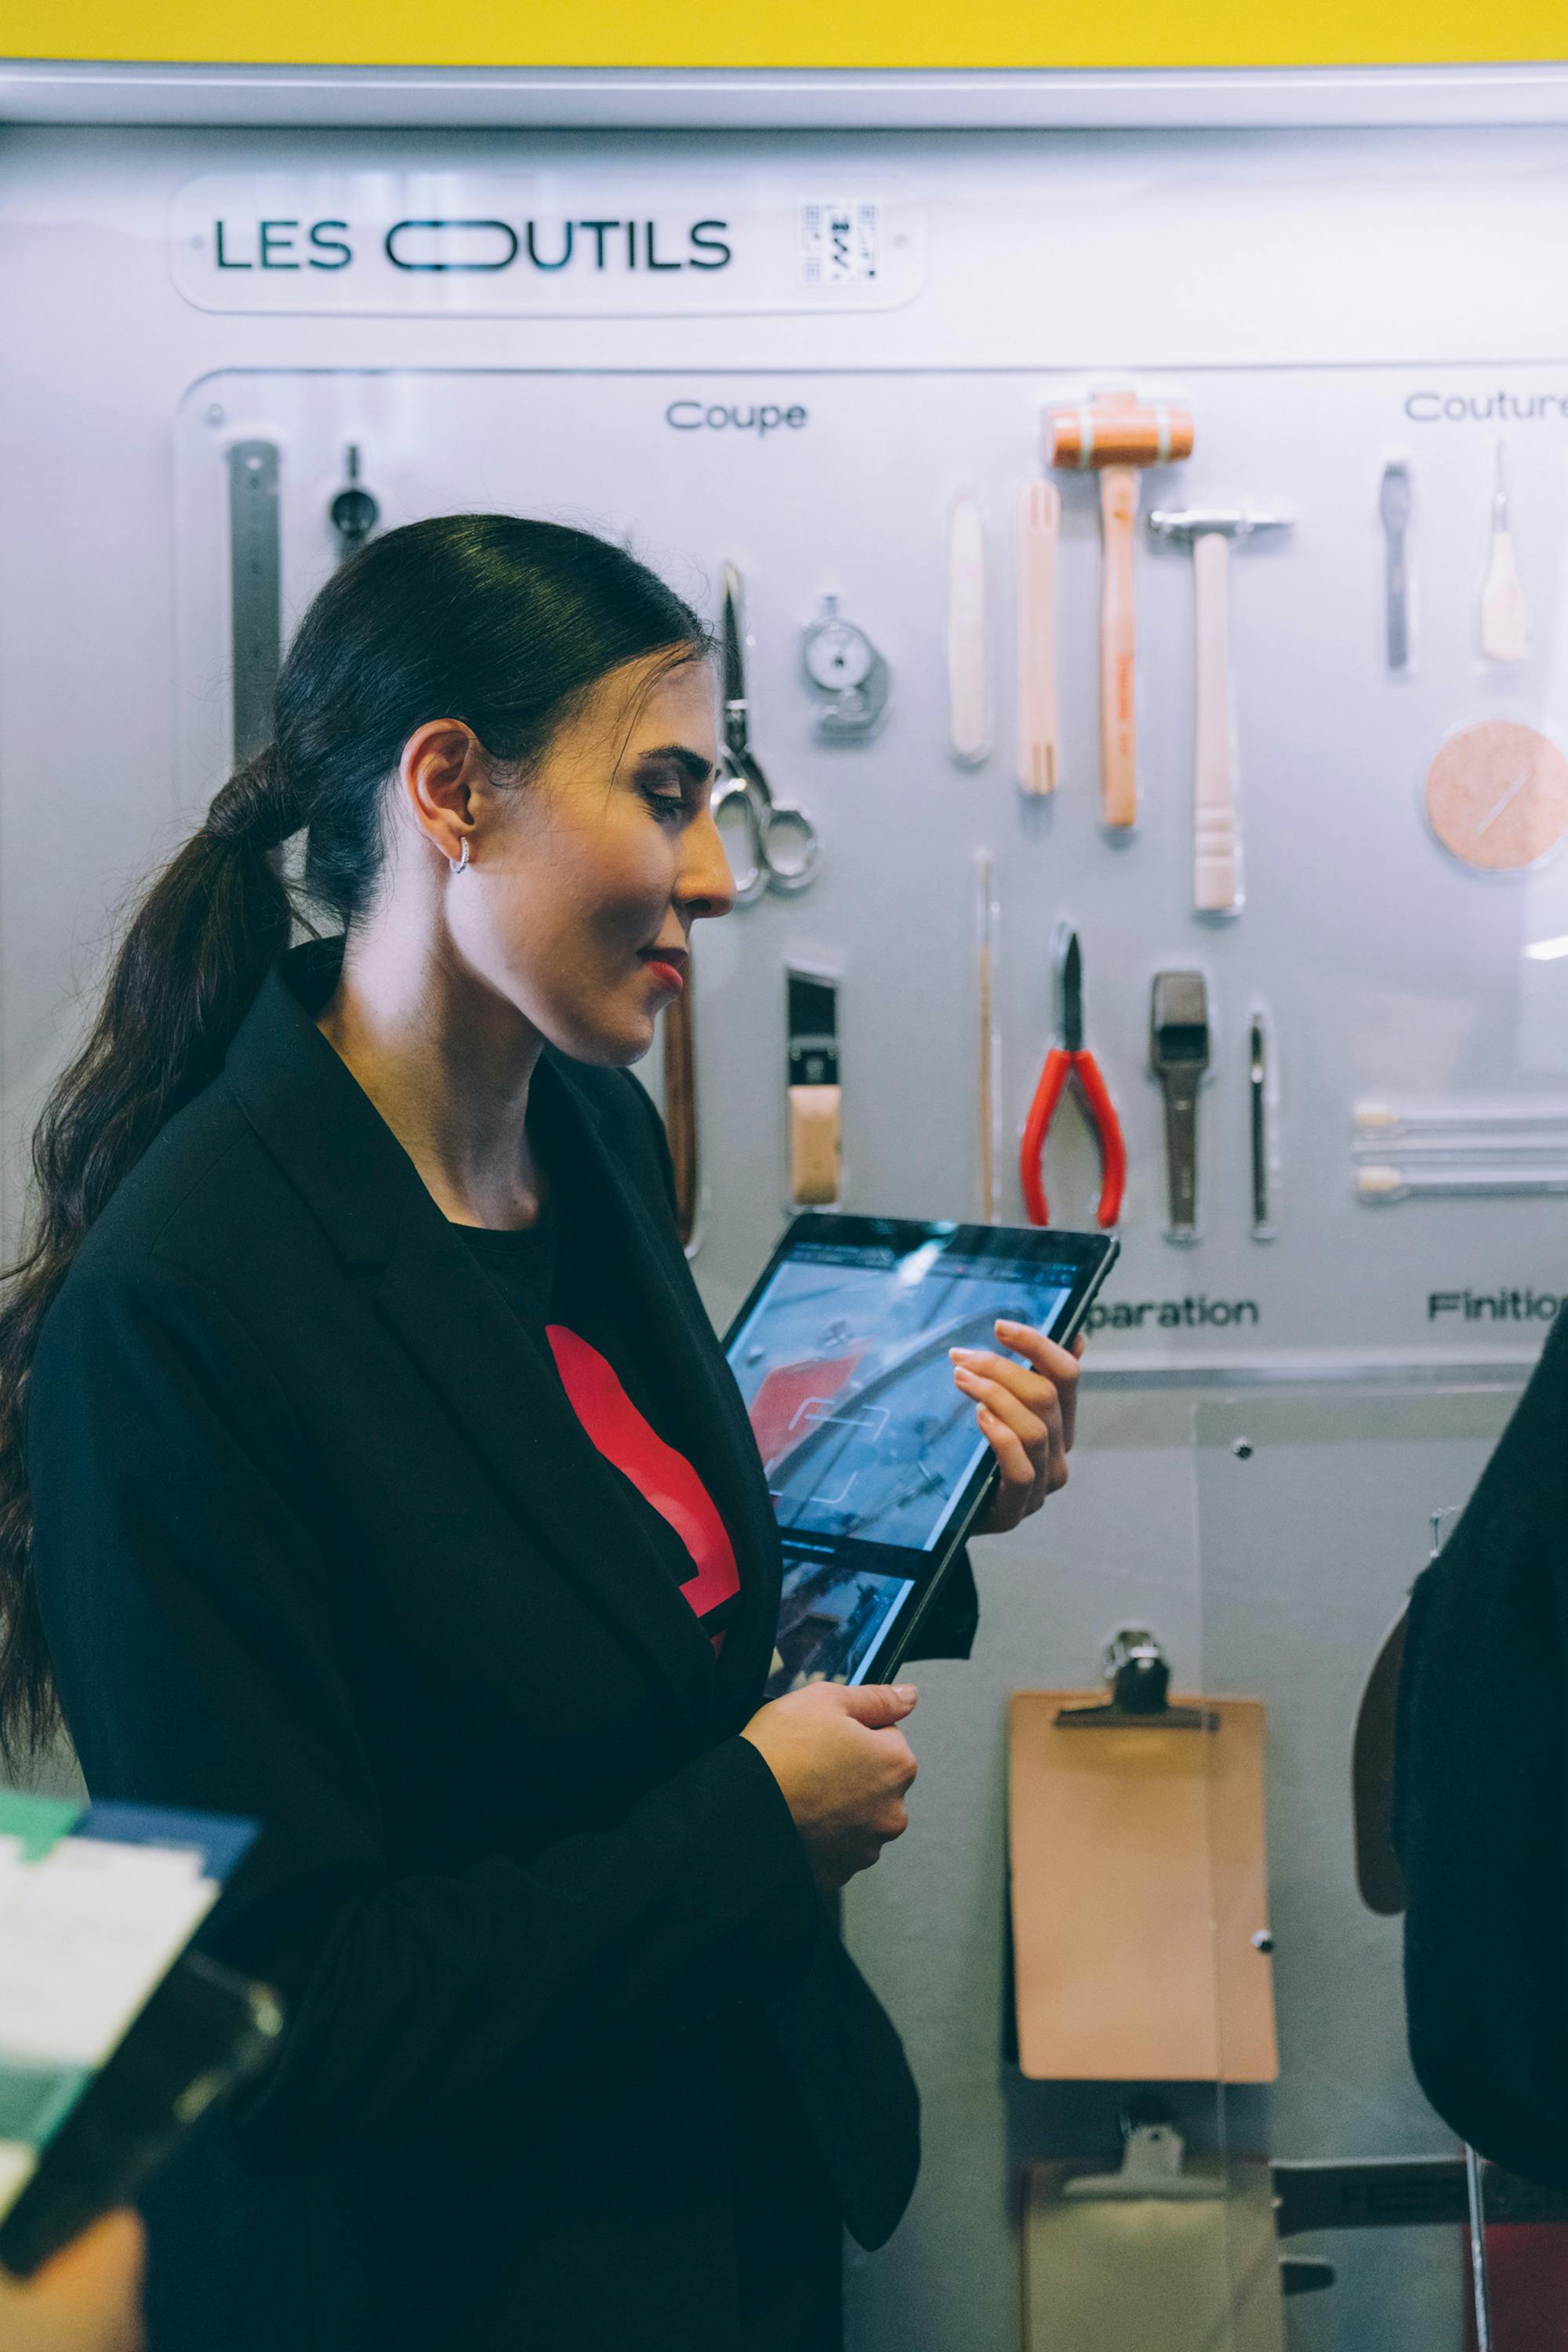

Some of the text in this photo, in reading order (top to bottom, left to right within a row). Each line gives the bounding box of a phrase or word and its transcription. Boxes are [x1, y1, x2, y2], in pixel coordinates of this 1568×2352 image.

[216, 220, 731, 273] LES OUTILS
[665, 400, 808, 437] Coupe
